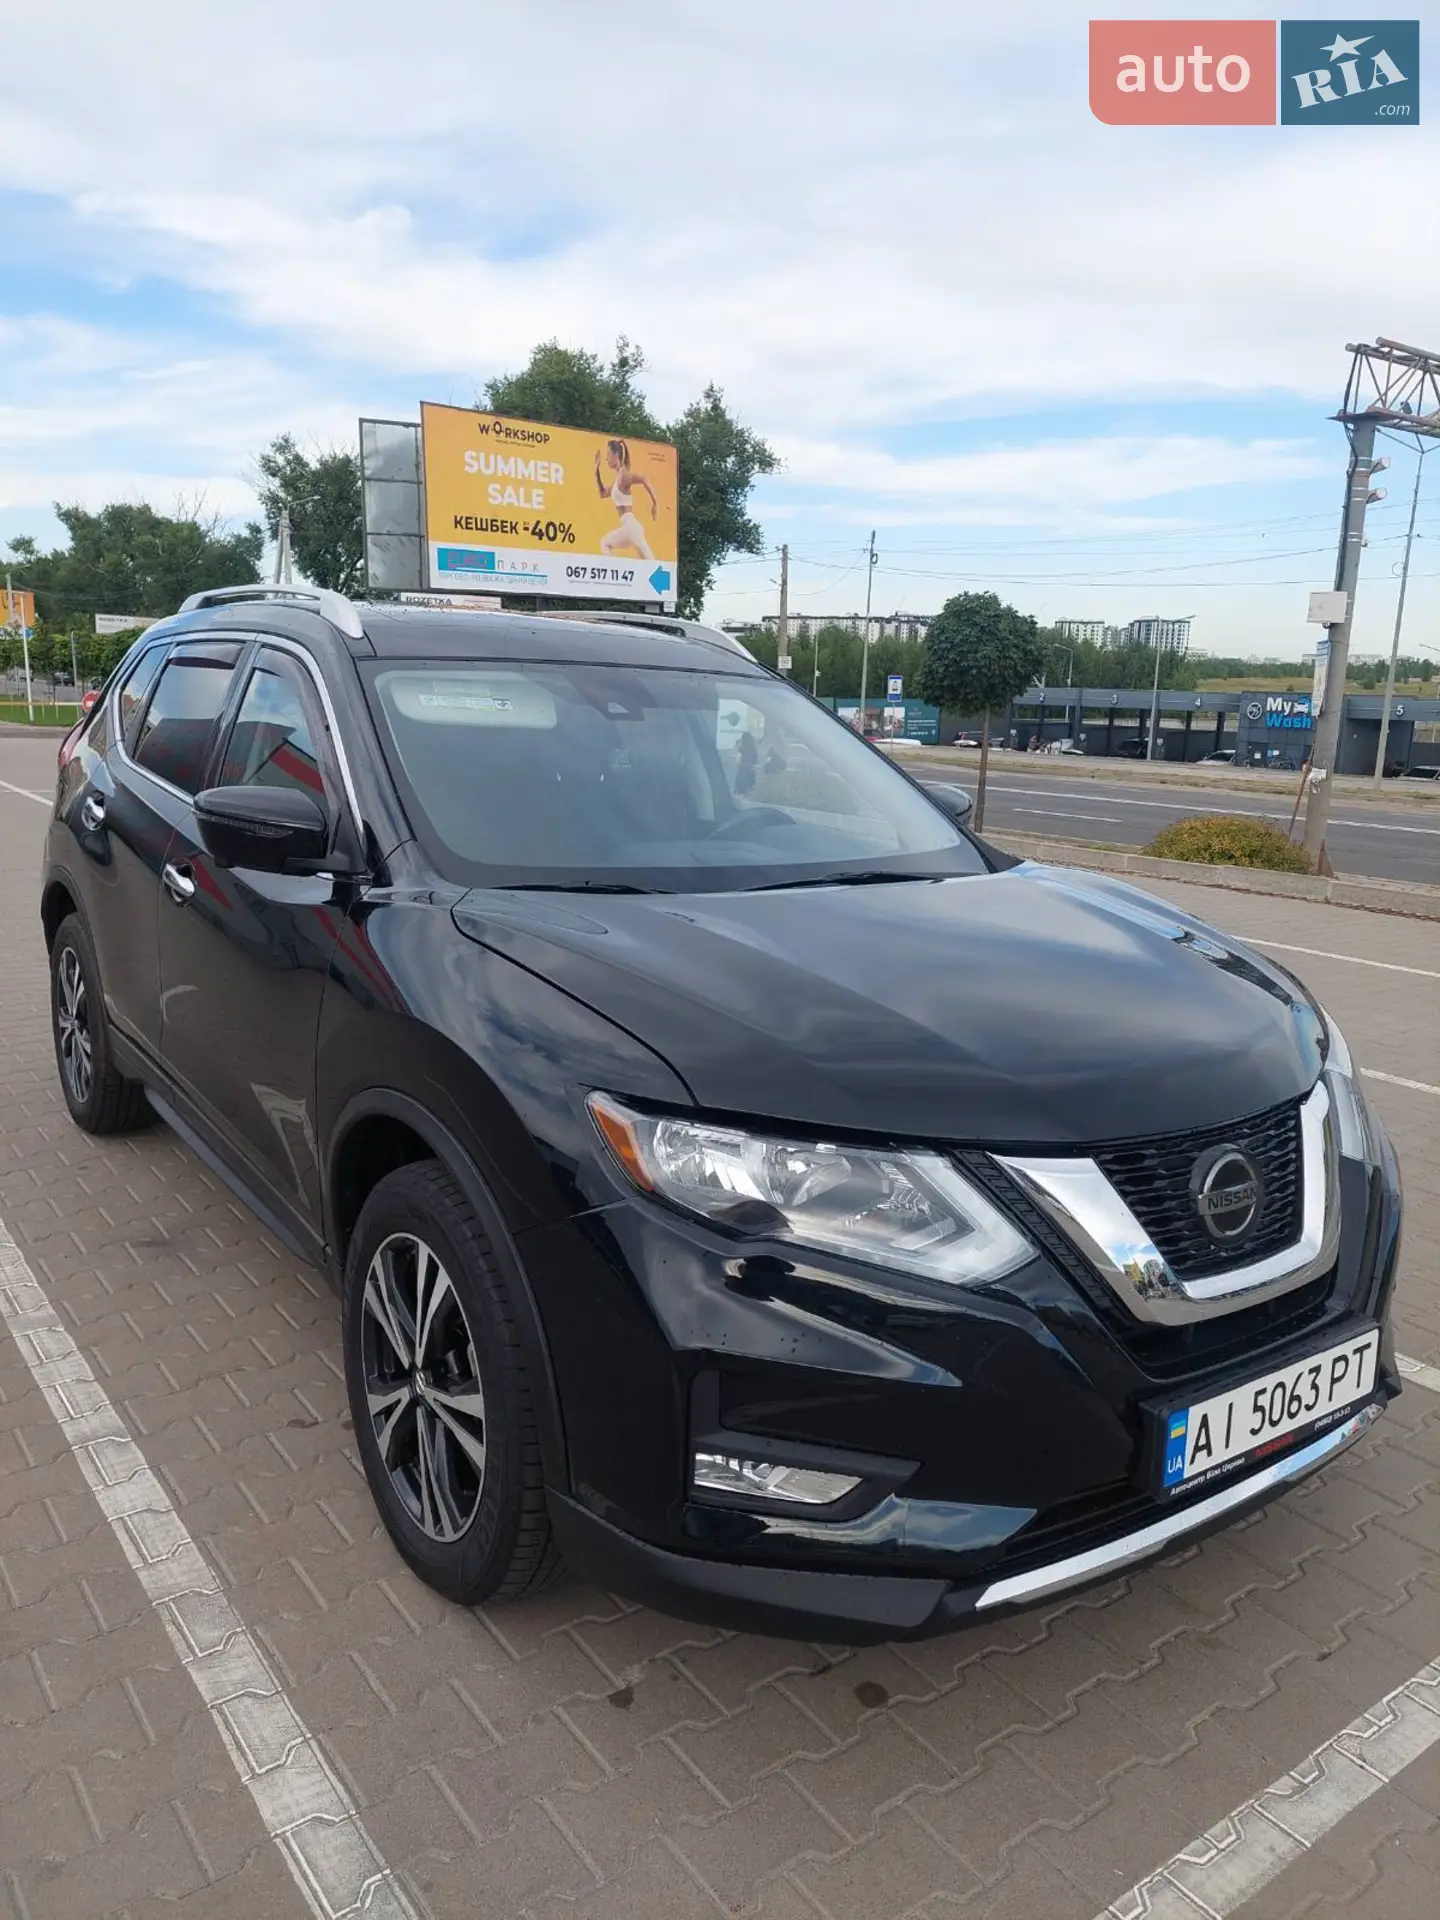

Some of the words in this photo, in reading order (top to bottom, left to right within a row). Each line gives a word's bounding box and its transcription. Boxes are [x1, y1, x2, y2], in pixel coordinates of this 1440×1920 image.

[478, 420, 551, 444] WORKSHOP
[464, 449, 565, 485] SUMMER
[487, 483, 545, 510] SALE
[453, 515, 519, 535] КЕШБЕК
[523, 520, 576, 544] -40%
[497, 560, 540, 573] ПАРК
[566, 565, 587, 579] 067
[590, 567, 608, 580] 517
[611, 569, 619, 581] 11
[621, 570, 635, 582] 47
[1111, 694, 1118, 704] 3
[1194, 697, 1202, 708] 4
[1266, 696, 1292, 716] My
[1396, 705, 1404, 716] 5
[1265, 712, 1313, 729] Wash
[1207, 1183, 1257, 1210] NISSAN
[1189, 1402, 1233, 1466] AI
[1249, 1363, 1322, 1436] 5063
[1328, 1342, 1372, 1403] PT
[1167, 1455, 1184, 1474] UA
